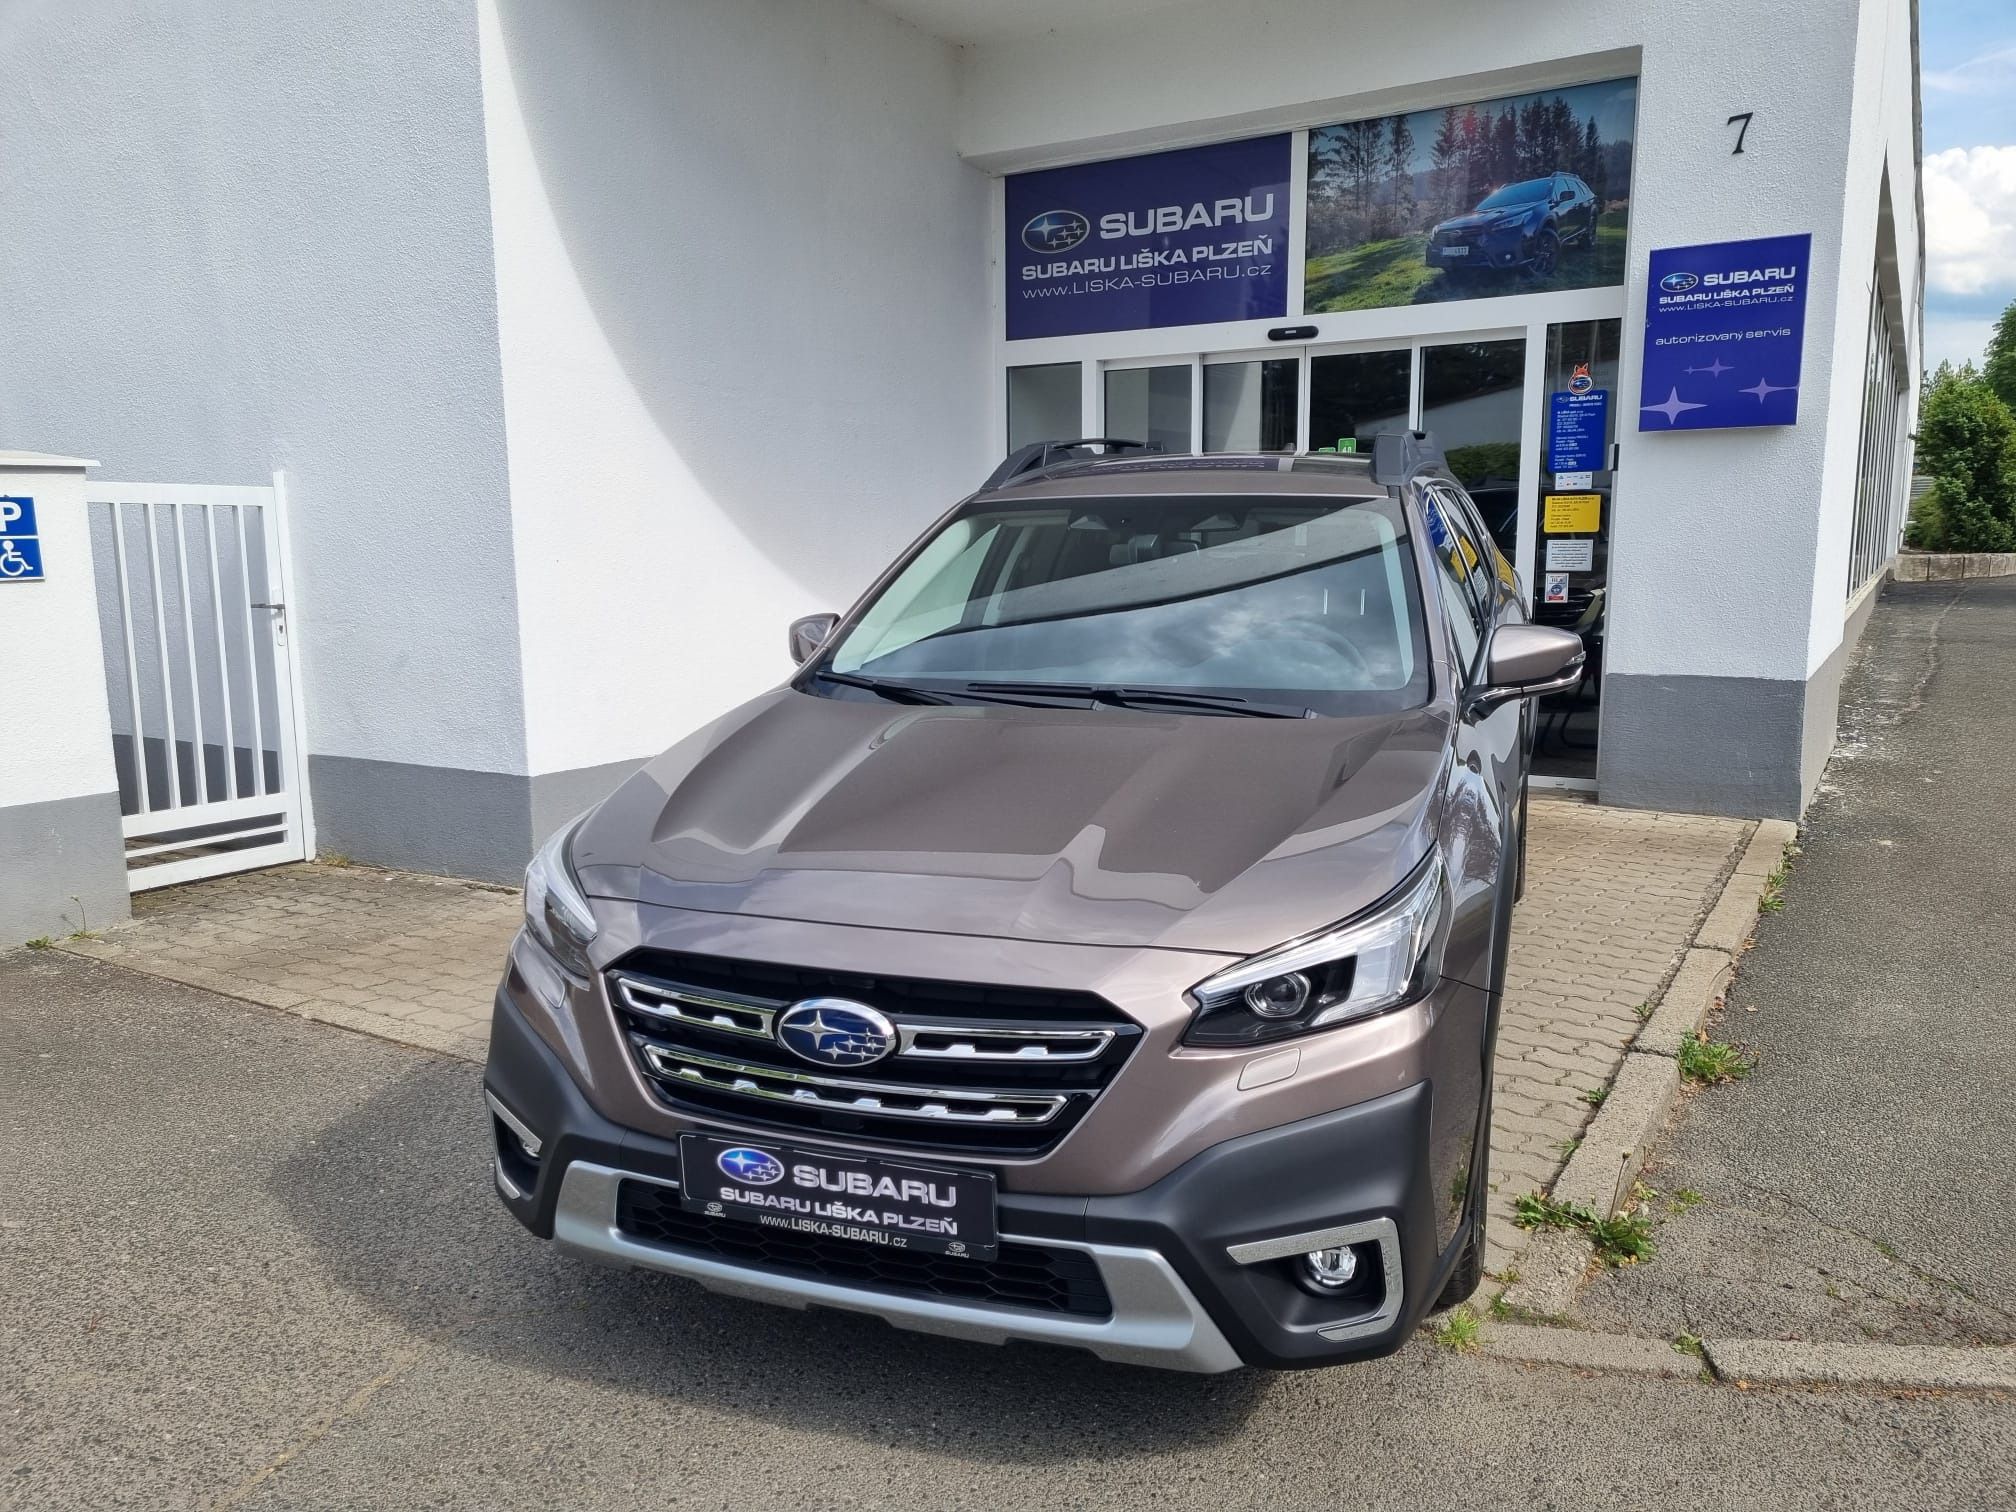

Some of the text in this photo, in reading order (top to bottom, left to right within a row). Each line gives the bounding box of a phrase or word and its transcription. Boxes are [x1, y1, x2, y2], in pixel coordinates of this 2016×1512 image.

[1727, 112, 1754, 156] 7
[1099, 193, 1274, 240] SUBARU
[1022, 234, 1273, 281] SUBARU LIŠKA PLZEŇ
[1022, 264, 1272, 299] www.LISKA-SUBARU.cz
[1703, 266, 1796, 286] SUBARU
[1659, 284, 1794, 305] SUBARU LIŠKA PLZEŇ
[1655, 327, 1791, 346] autorizovaný servis
[1569, 394, 1603, 402] SUBARU
[0, 501, 22, 532] P
[793, 1165, 957, 1208] SUBARU
[719, 1187, 958, 1236] SUBARU LIŠKA PLZEŇ
[760, 1215, 907, 1248] www.LISKA-SUBARU.cz
[945, 1250, 970, 1259] SUBARU
